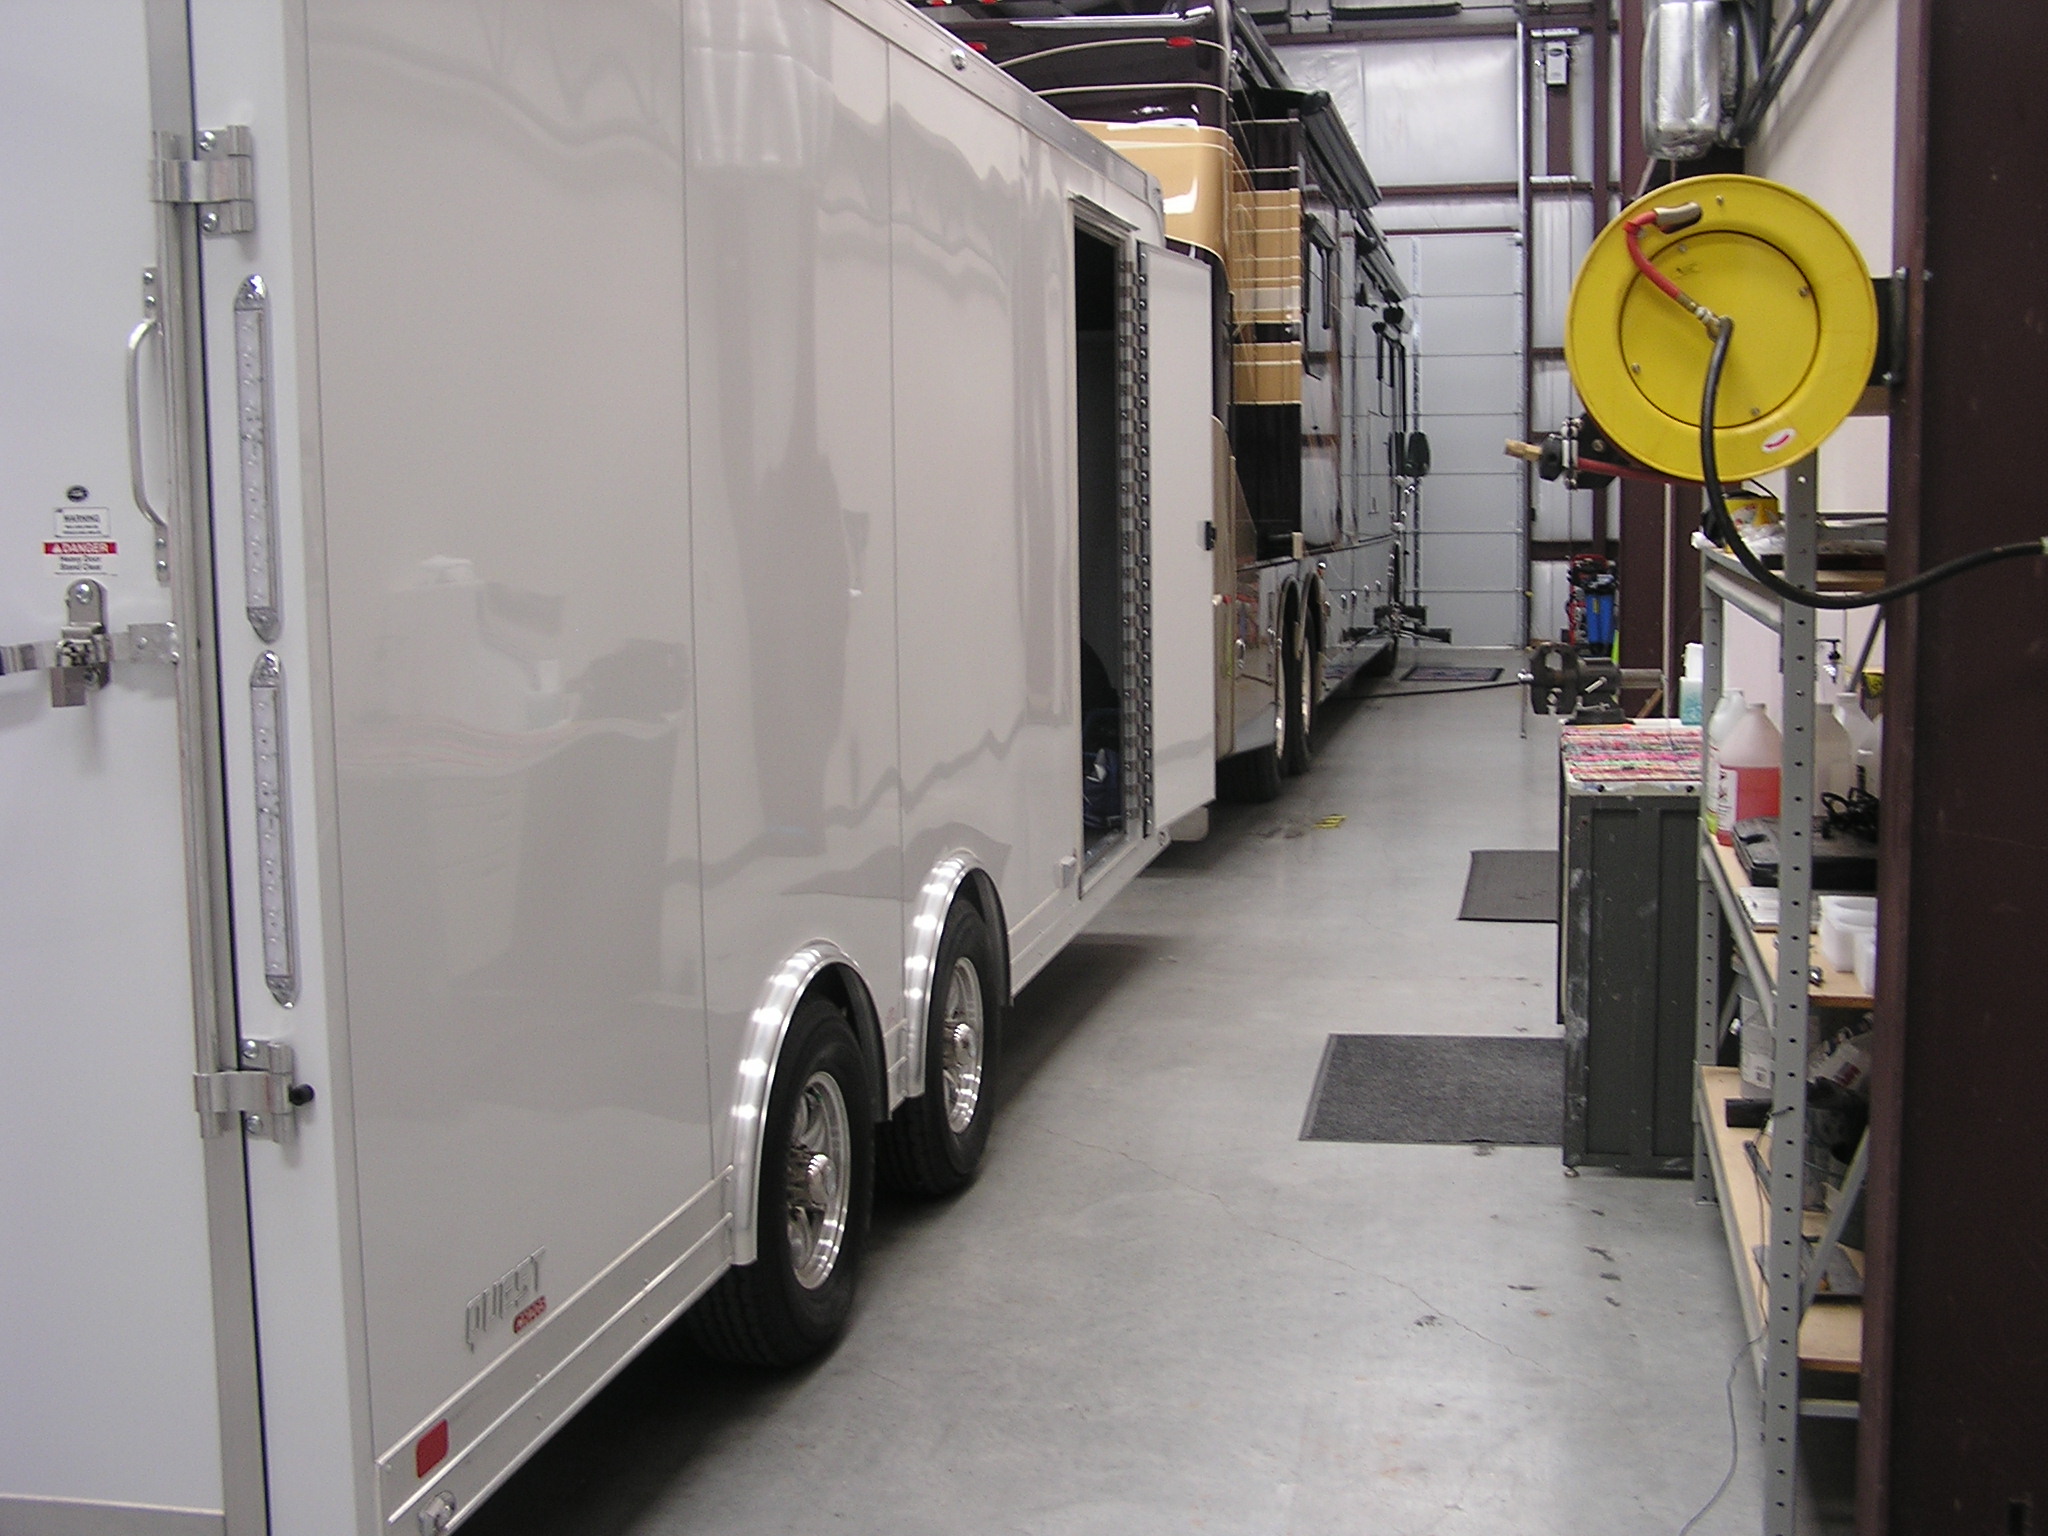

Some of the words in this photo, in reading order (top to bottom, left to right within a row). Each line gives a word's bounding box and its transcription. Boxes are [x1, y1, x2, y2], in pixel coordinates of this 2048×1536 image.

[64, 514, 100, 522] WARNING
[62, 543, 109, 554] DANGER
[465, 1245, 546, 1354] QUEST
